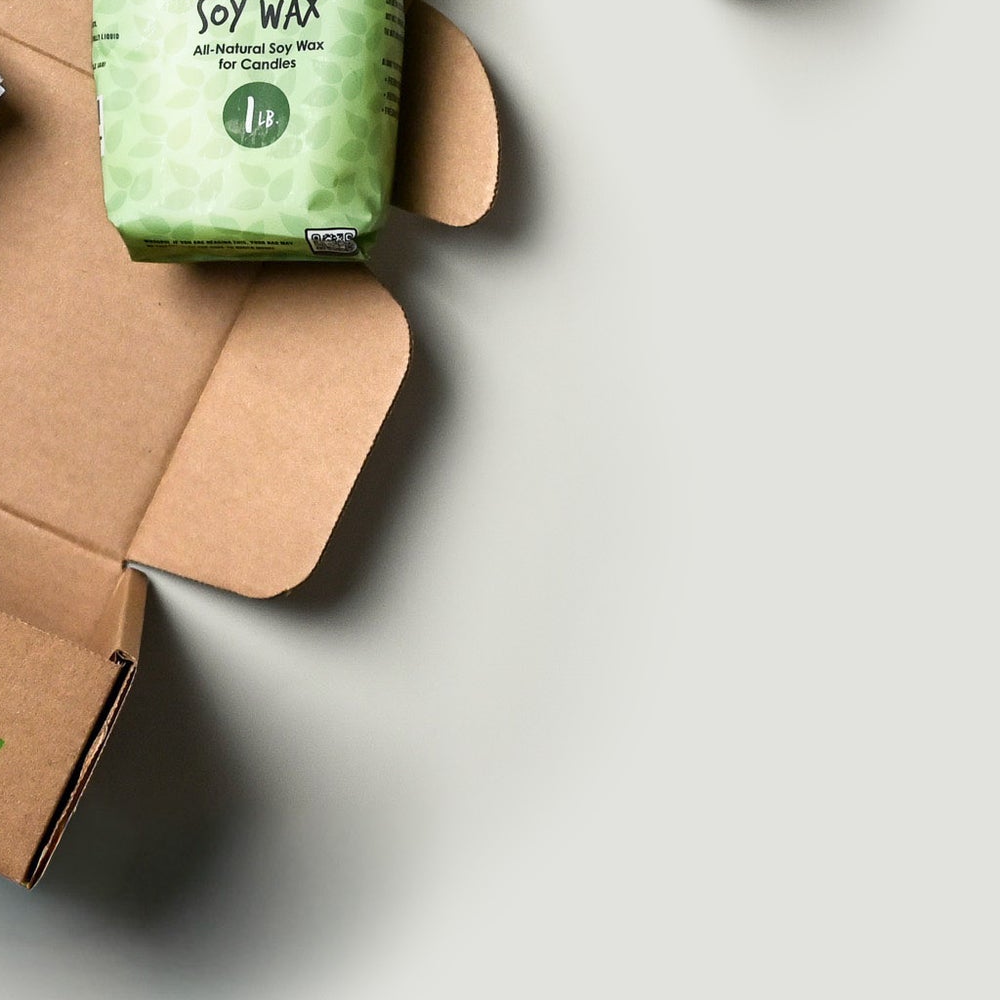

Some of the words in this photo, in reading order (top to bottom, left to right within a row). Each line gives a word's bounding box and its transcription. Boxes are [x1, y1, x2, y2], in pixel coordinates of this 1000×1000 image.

[193, 42, 265, 56] All-Natural
[269, 42, 292, 55] Soy
[296, 39, 324, 52] Wax
[218, 57, 237, 70] for
[240, 57, 296, 70] Candles
[245, 95, 255, 133] 1
